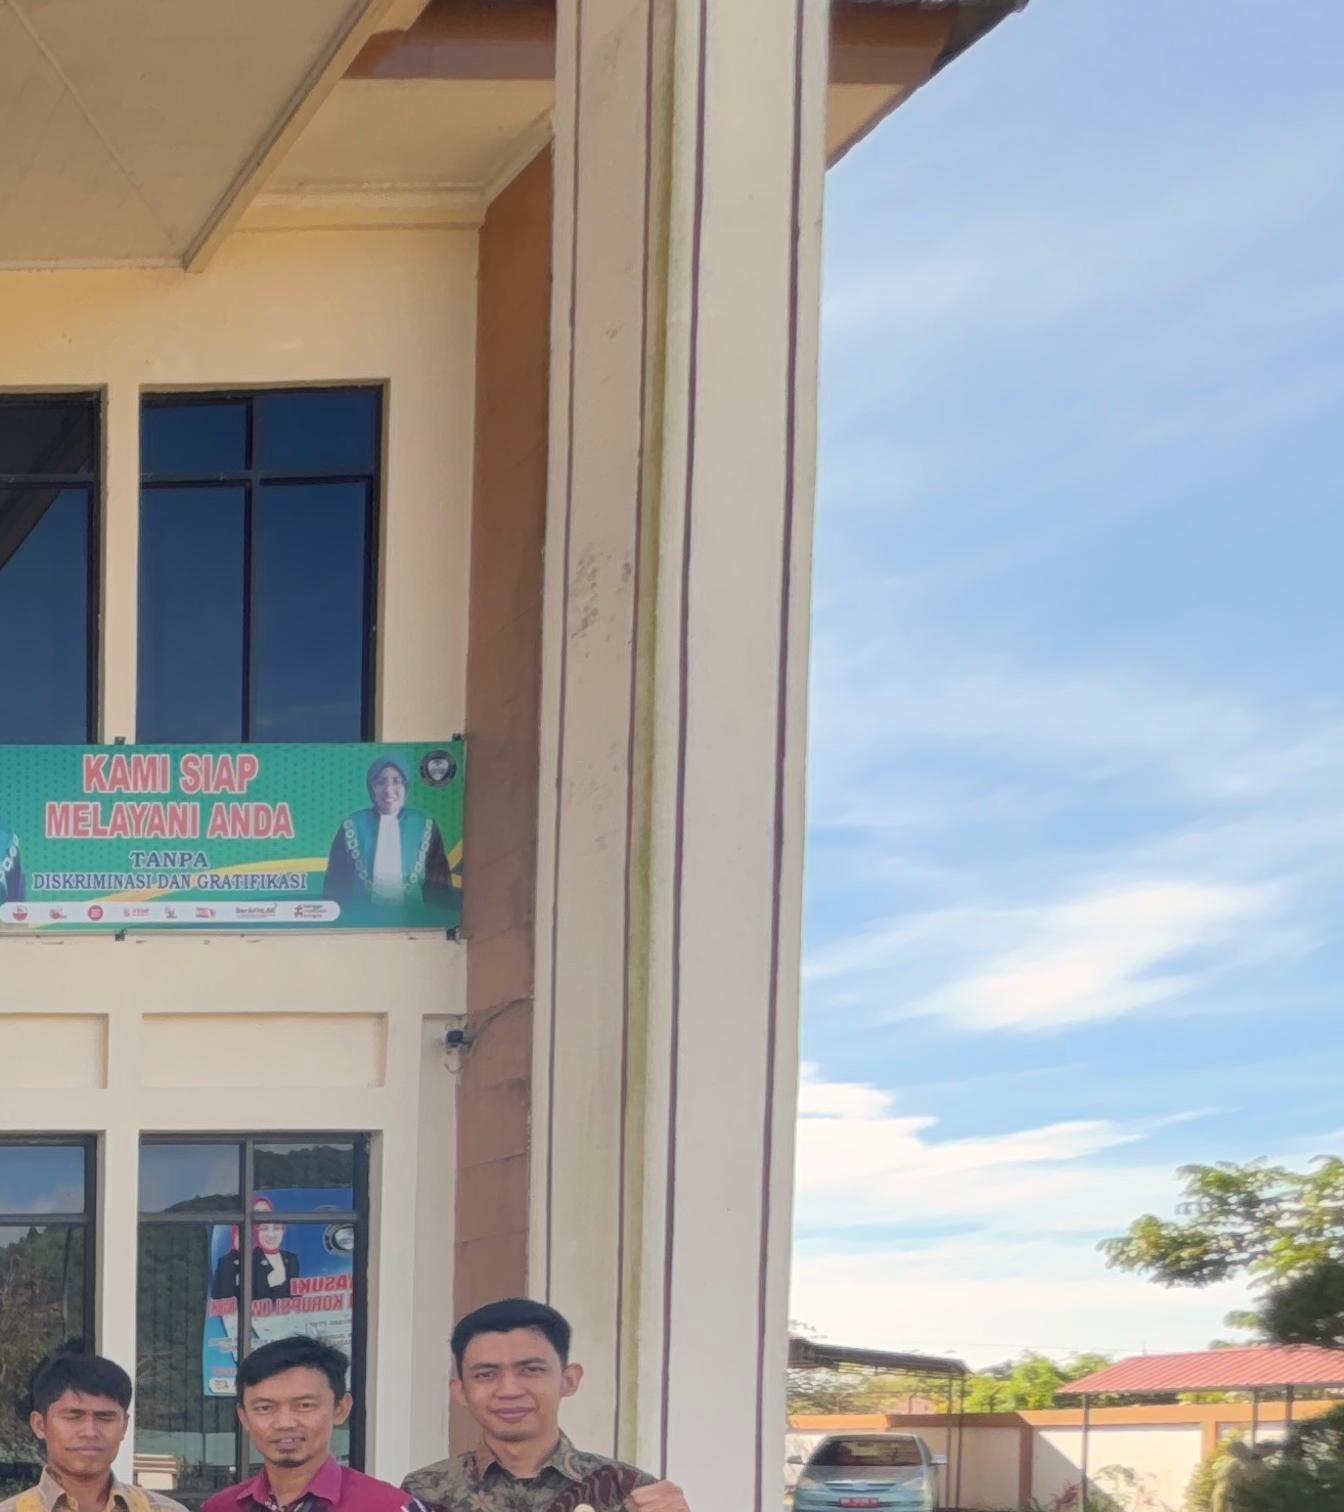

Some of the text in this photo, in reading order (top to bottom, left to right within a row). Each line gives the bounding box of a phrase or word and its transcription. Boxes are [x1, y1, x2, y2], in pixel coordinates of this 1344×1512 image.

[83, 754, 259, 794] KAMI SIAP
[45, 801, 296, 839] MELAYANI ANDA
[128, 851, 209, 869] TANPA
[32, 872, 307, 891] DISKRIMINASI DAN GRATIFIKASI
